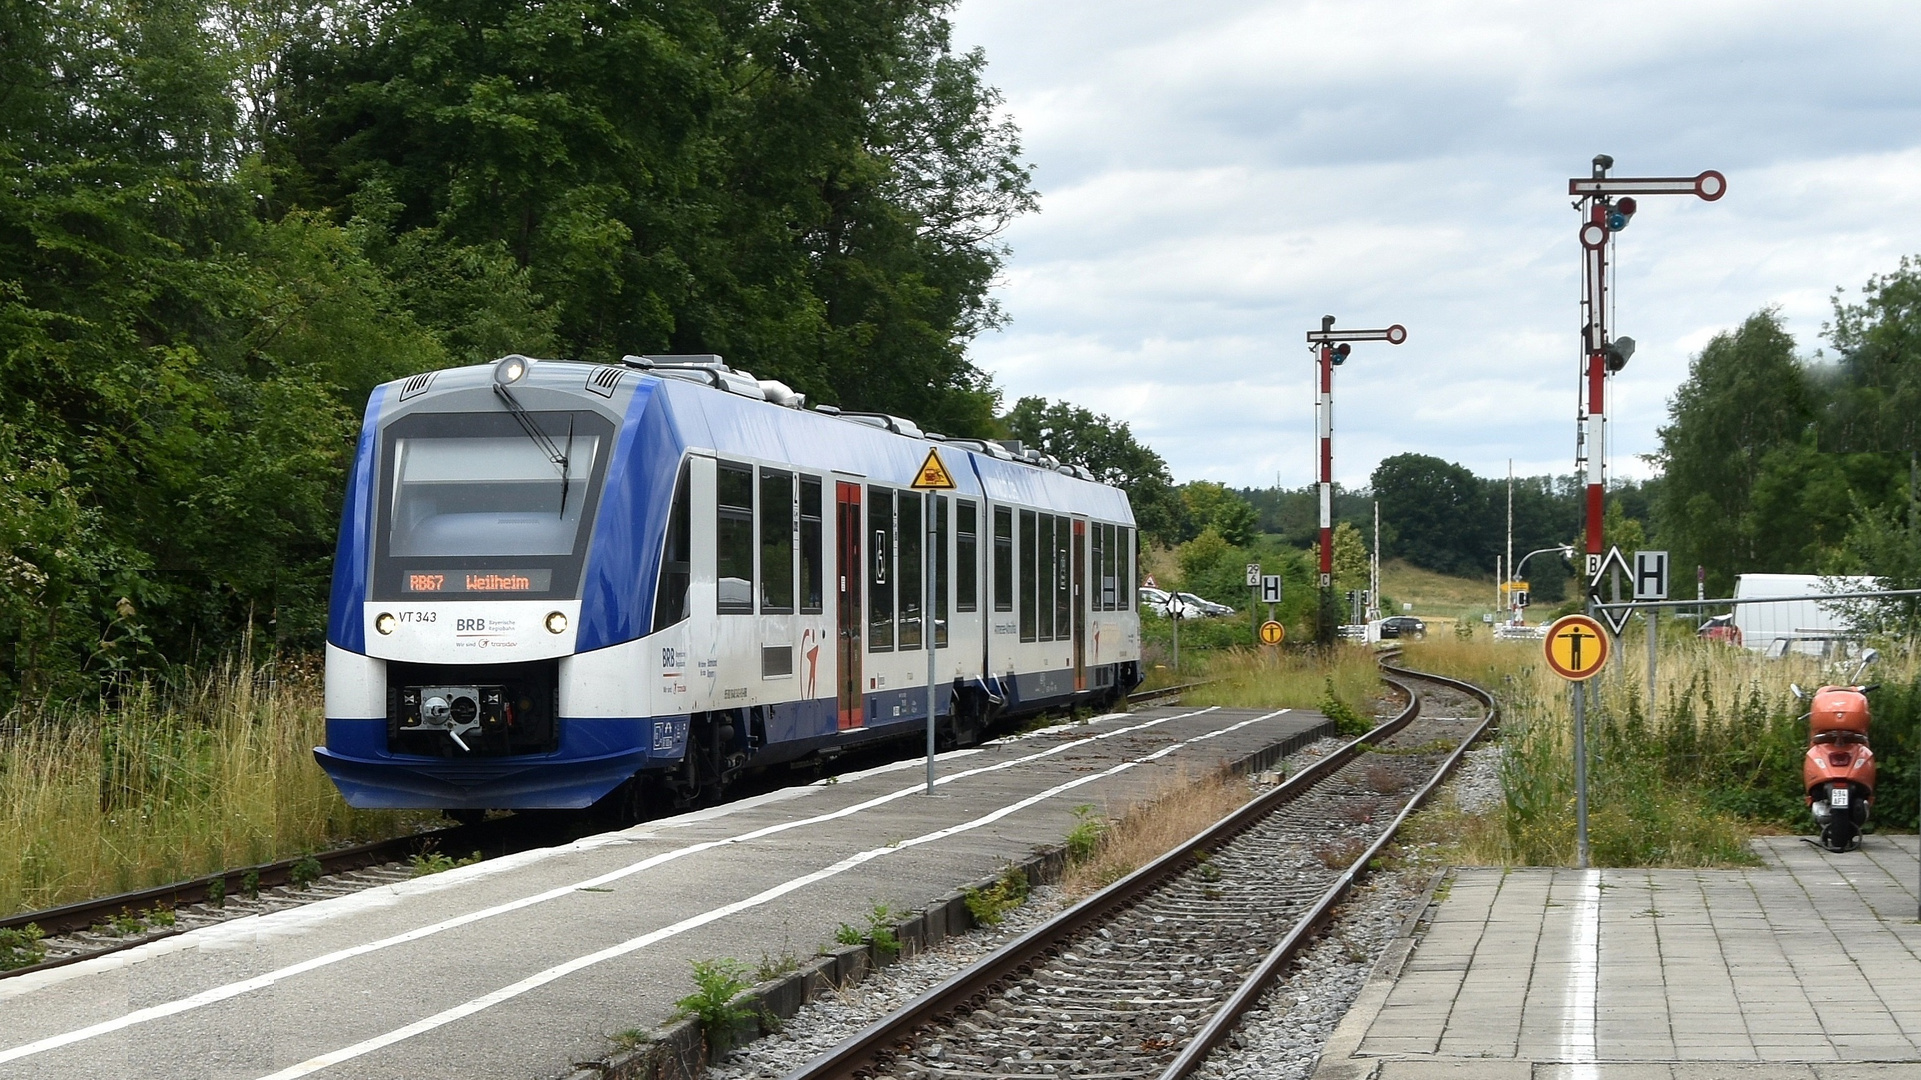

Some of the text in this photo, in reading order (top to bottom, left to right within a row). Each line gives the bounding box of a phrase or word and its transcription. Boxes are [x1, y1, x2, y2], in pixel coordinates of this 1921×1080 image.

[1247, 564, 1259, 575] 29
[1590, 557, 1597, 573] B
[1250, 575, 1257, 584] 6
[1322, 574, 1328, 586] C
[1638, 555, 1664, 595] H
[409, 574, 530, 591] RB67 Weilheim
[1264, 577, 1279, 600] H
[399, 611, 437, 623] VT 343
[456, 618, 486, 631] BRB
[662, 647, 675, 668] BRB
